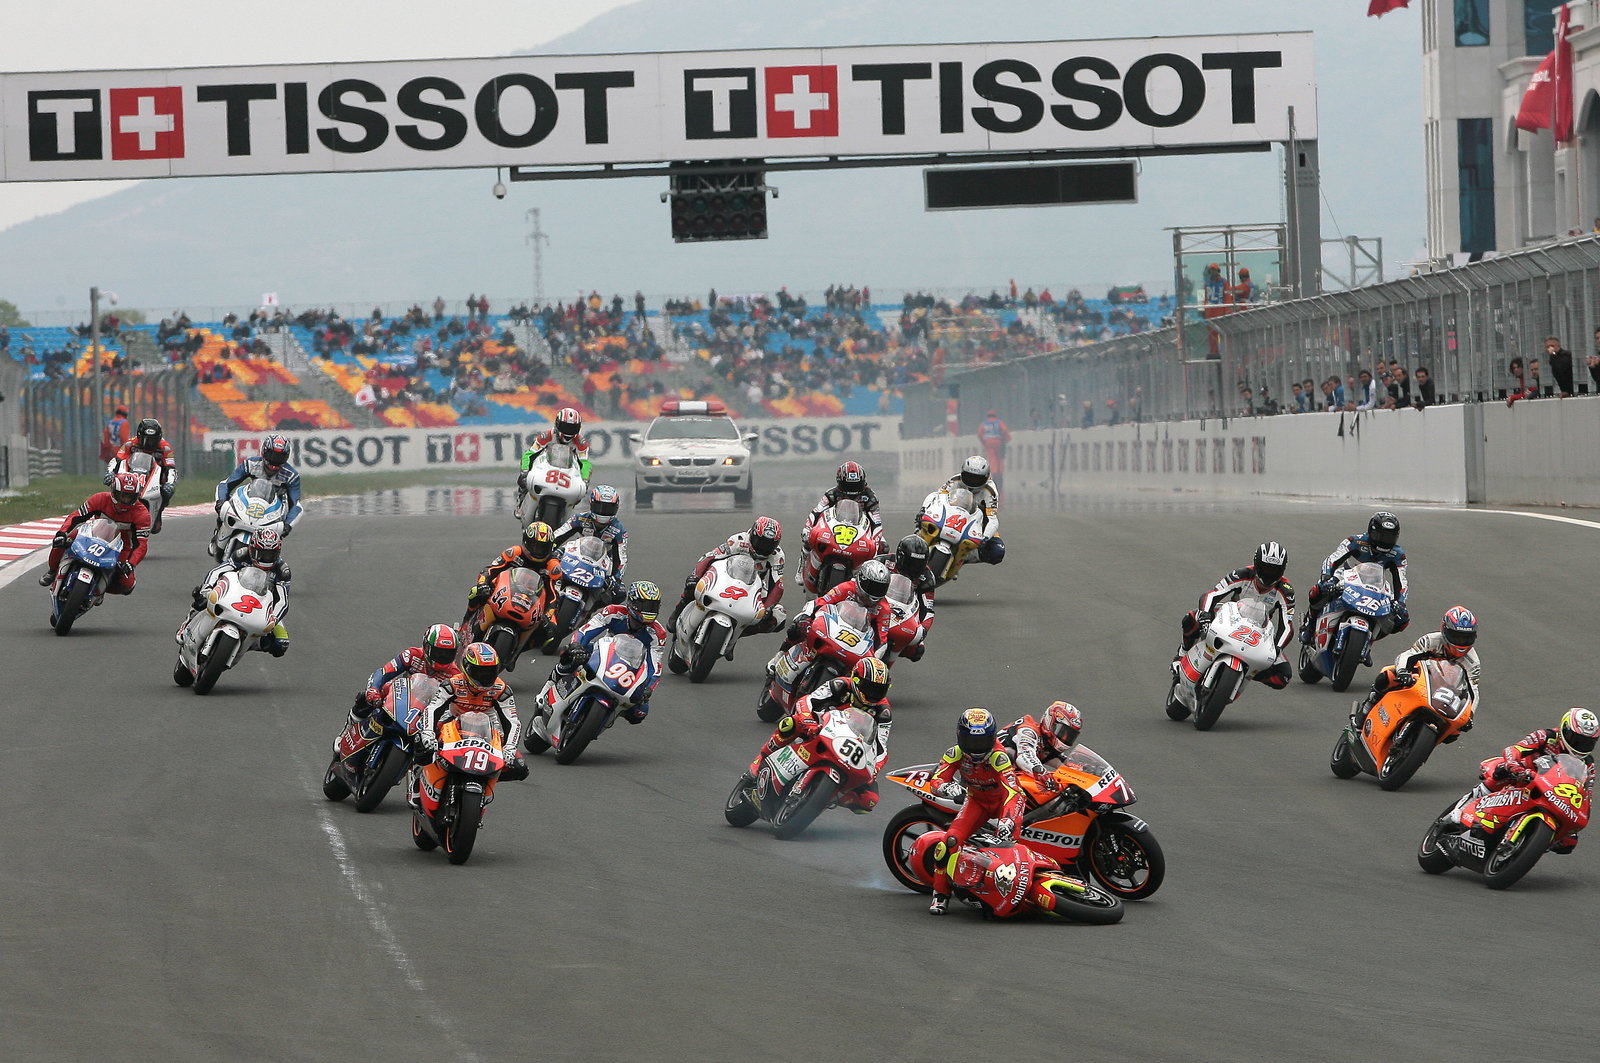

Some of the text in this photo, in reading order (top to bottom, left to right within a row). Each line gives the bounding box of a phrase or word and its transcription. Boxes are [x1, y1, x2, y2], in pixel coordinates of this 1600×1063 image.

[851, 51, 1282, 136] TISSOT
[196, 70, 635, 157] TISSOT
[484, 427, 639, 463] TIOT
[740, 421, 881, 456] ISSOT
[290, 434, 411, 468] ISSOT
[545, 469, 571, 489] 85
[245, 503, 265, 519] 22
[944, 514, 967, 534] 41
[86, 543, 106, 557] 40
[569, 567, 595, 583] 23
[231, 594, 263, 614] 8
[491, 586, 509, 612] 54
[1355, 595, 1381, 612] 36
[1228, 625, 1263, 648] 25
[604, 662, 636, 688] 96
[453, 739, 495, 755] REPSOL
[839, 738, 864, 767] 58
[464, 750, 489, 771] 19
[904, 770, 930, 788] 73
[906, 786, 937, 802] REPSOL
[1553, 783, 1583, 809] 80
[1020, 829, 1081, 846] REPSOL
